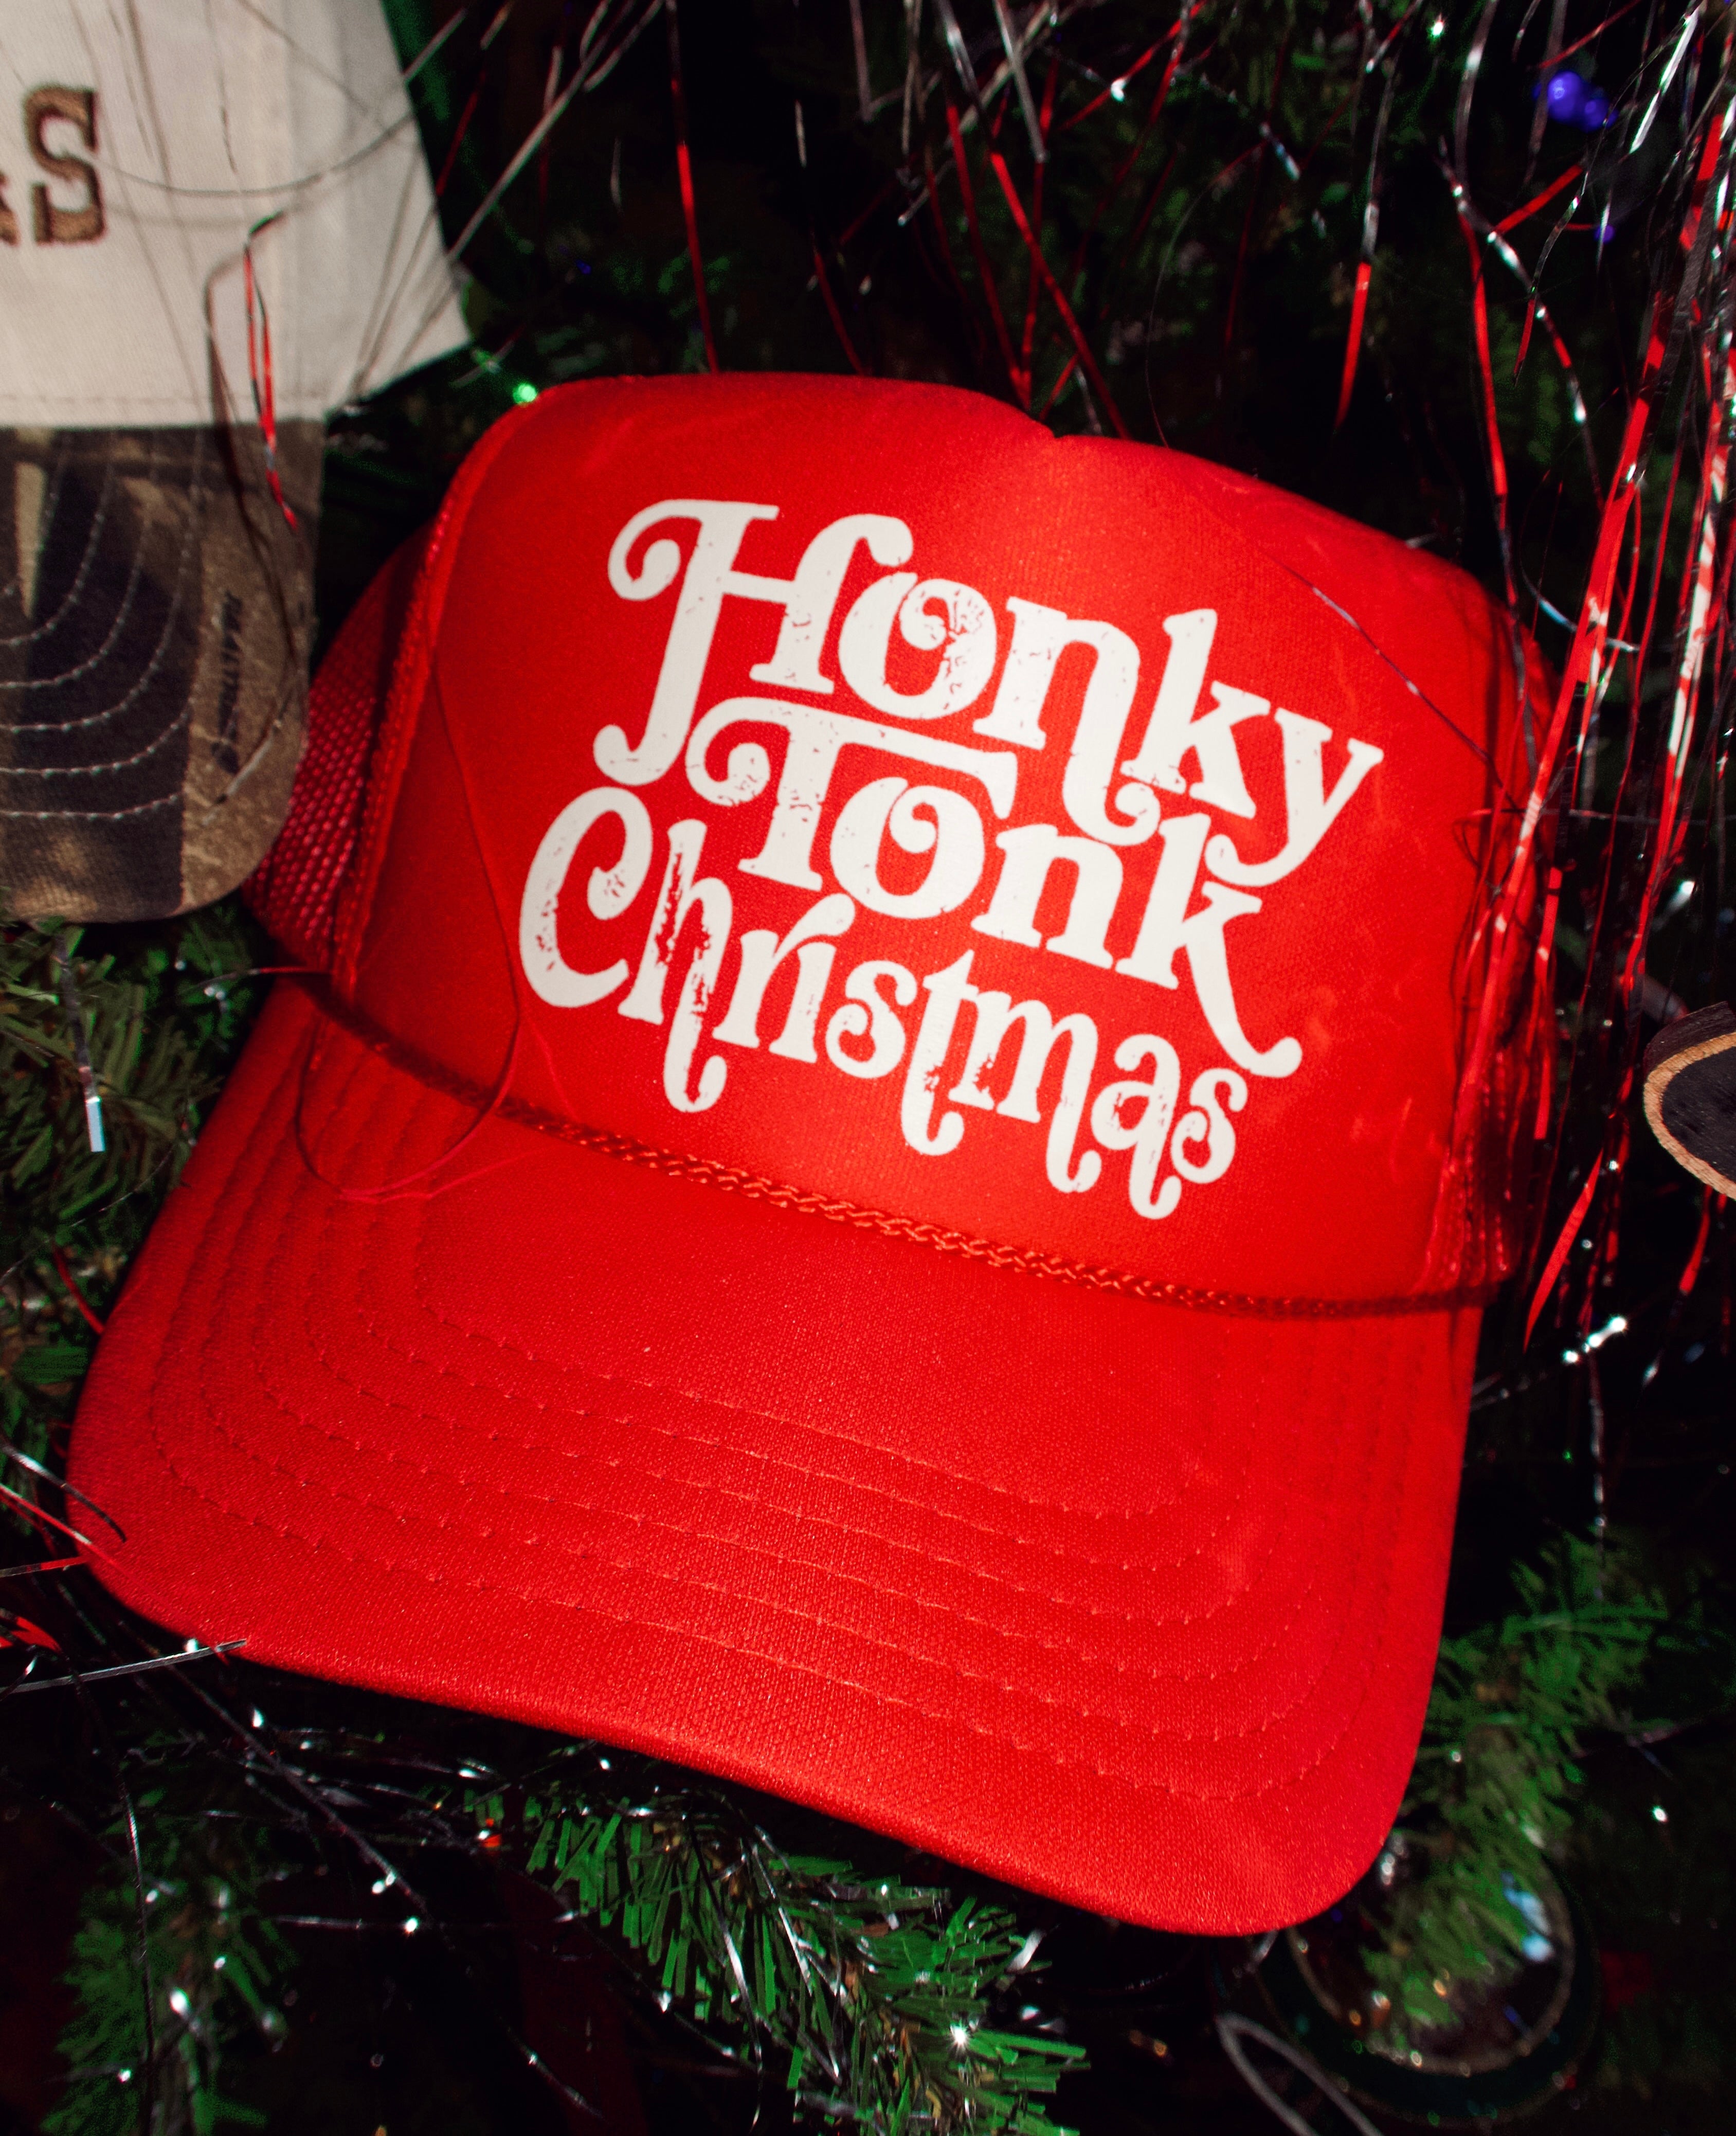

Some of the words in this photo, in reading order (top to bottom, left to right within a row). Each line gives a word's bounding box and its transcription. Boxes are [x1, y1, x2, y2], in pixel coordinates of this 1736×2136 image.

[593, 499, 1384, 888] Honky
[684, 696, 1304, 1079] Tonk
[519, 786, 1249, 1220] Christmas
